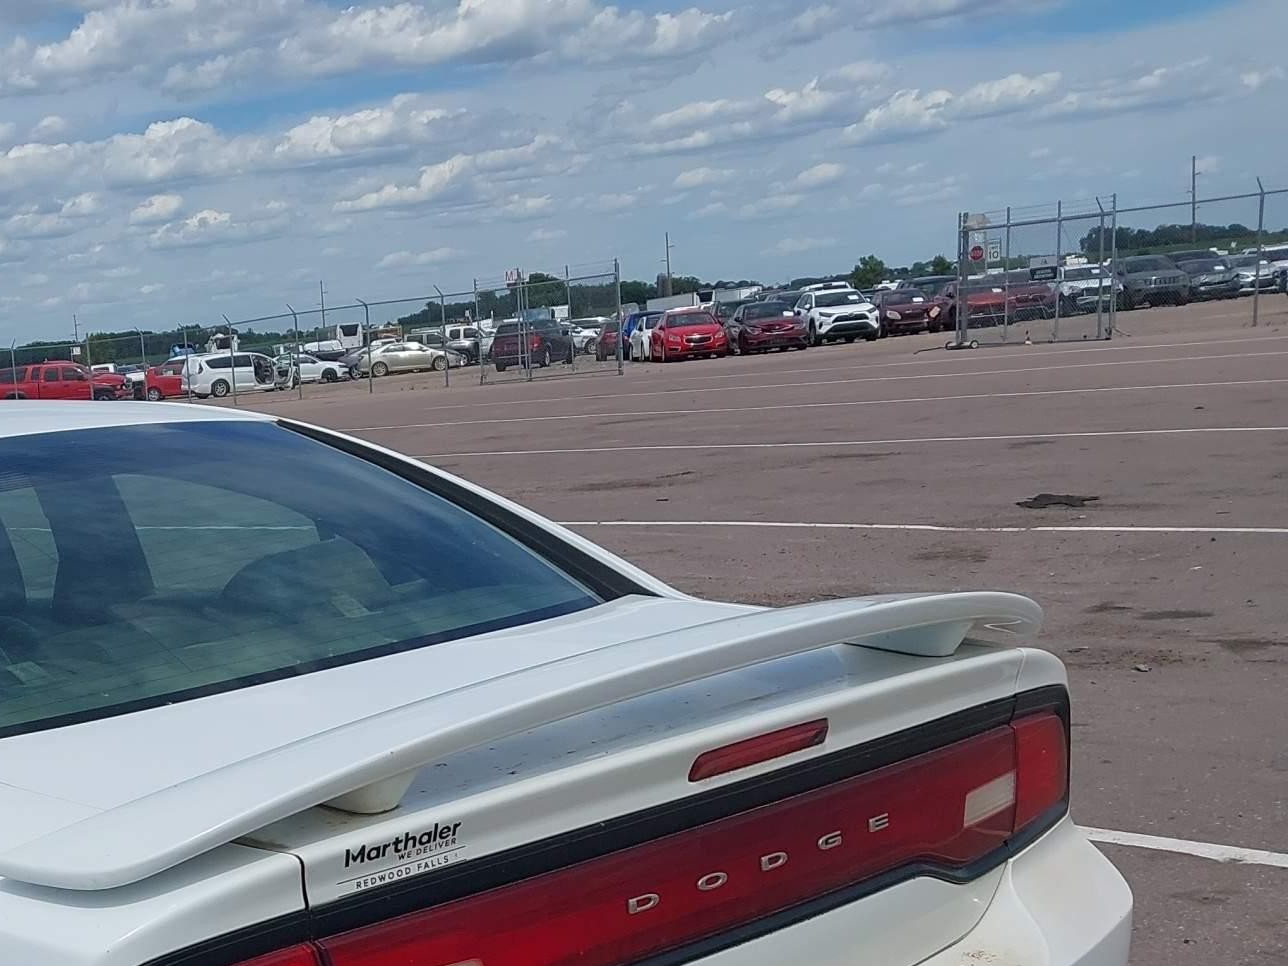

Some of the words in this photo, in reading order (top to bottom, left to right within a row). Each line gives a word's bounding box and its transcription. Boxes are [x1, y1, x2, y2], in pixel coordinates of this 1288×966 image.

[344, 821, 462, 868] Marthaler
[398, 851, 412, 861] WE
[416, 837, 456, 856] DELIVER
[627, 813, 889, 914] DODGE
[356, 867, 411, 889] REDWOOD
[417, 855, 449, 871] FALLS
